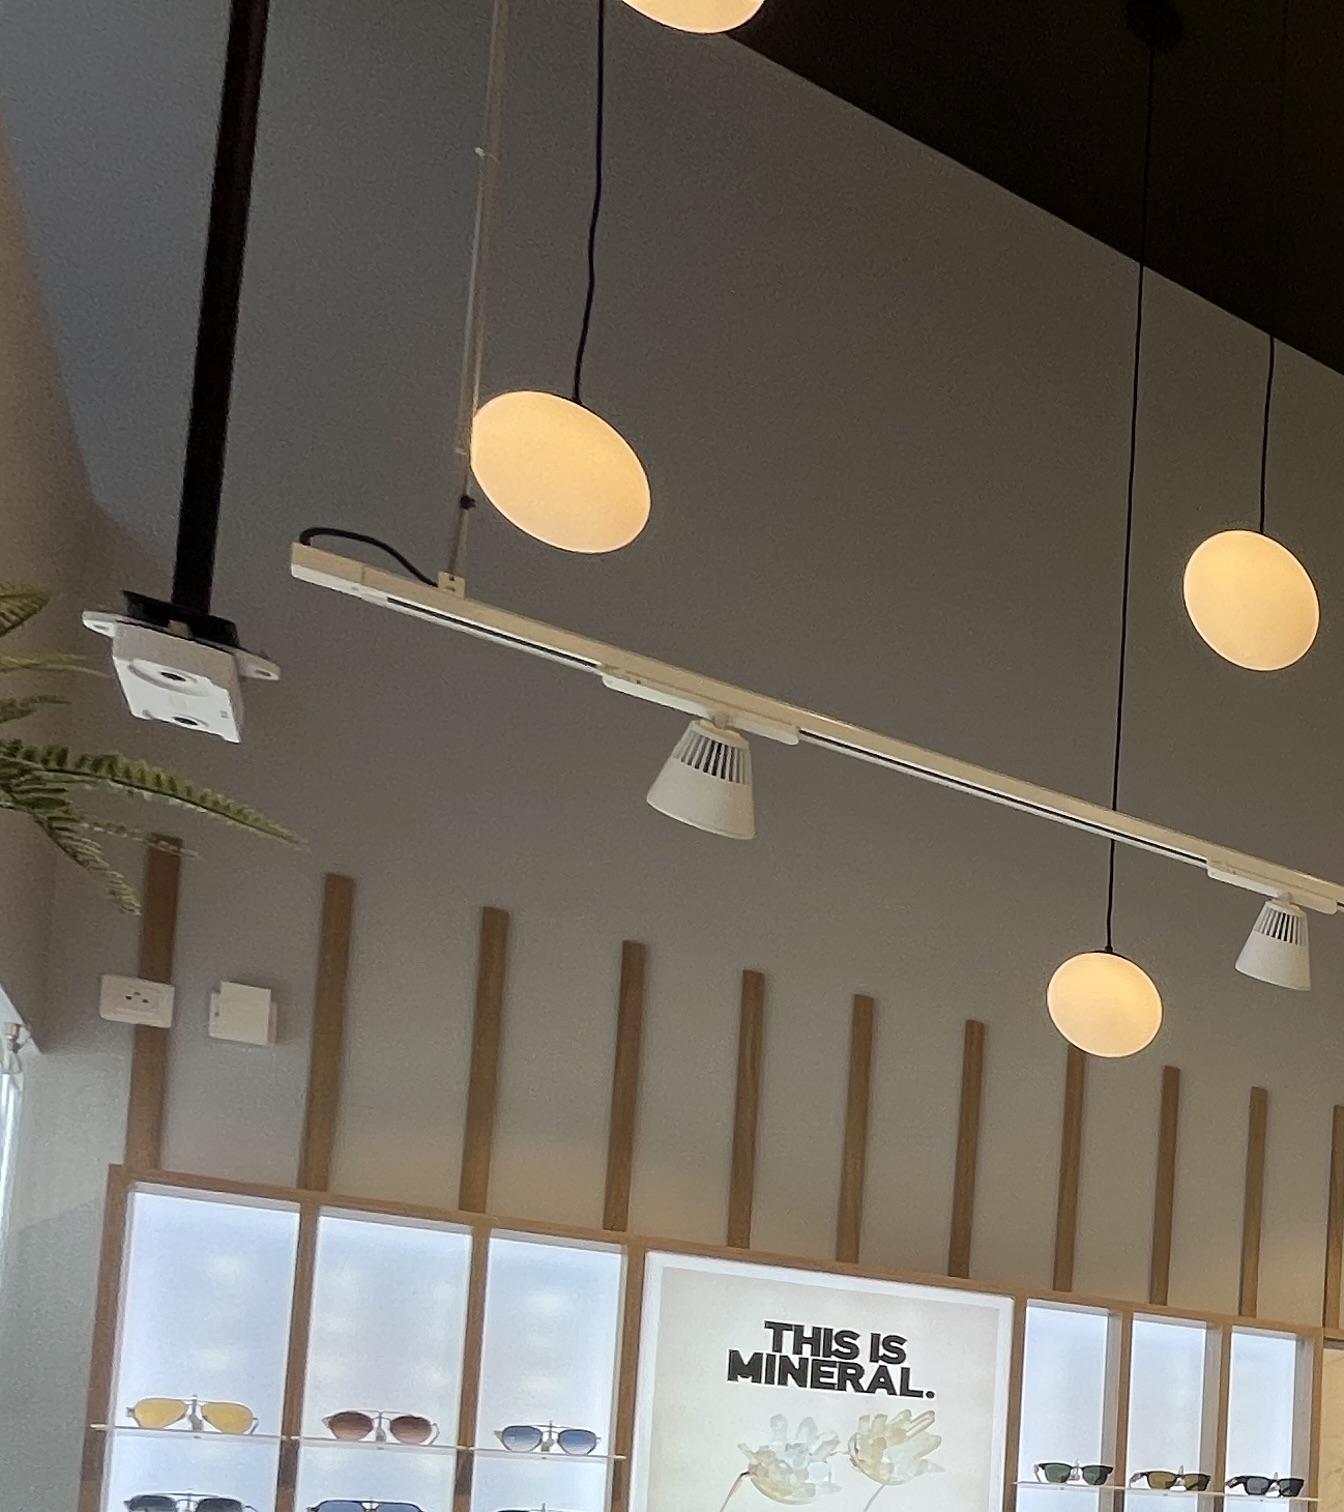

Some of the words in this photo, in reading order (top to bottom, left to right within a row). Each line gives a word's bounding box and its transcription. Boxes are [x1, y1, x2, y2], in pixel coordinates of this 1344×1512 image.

[764, 1320, 861, 1360] THIS
[869, 1332, 908, 1365] IS
[727, 1349, 935, 1399] MINERAL.
